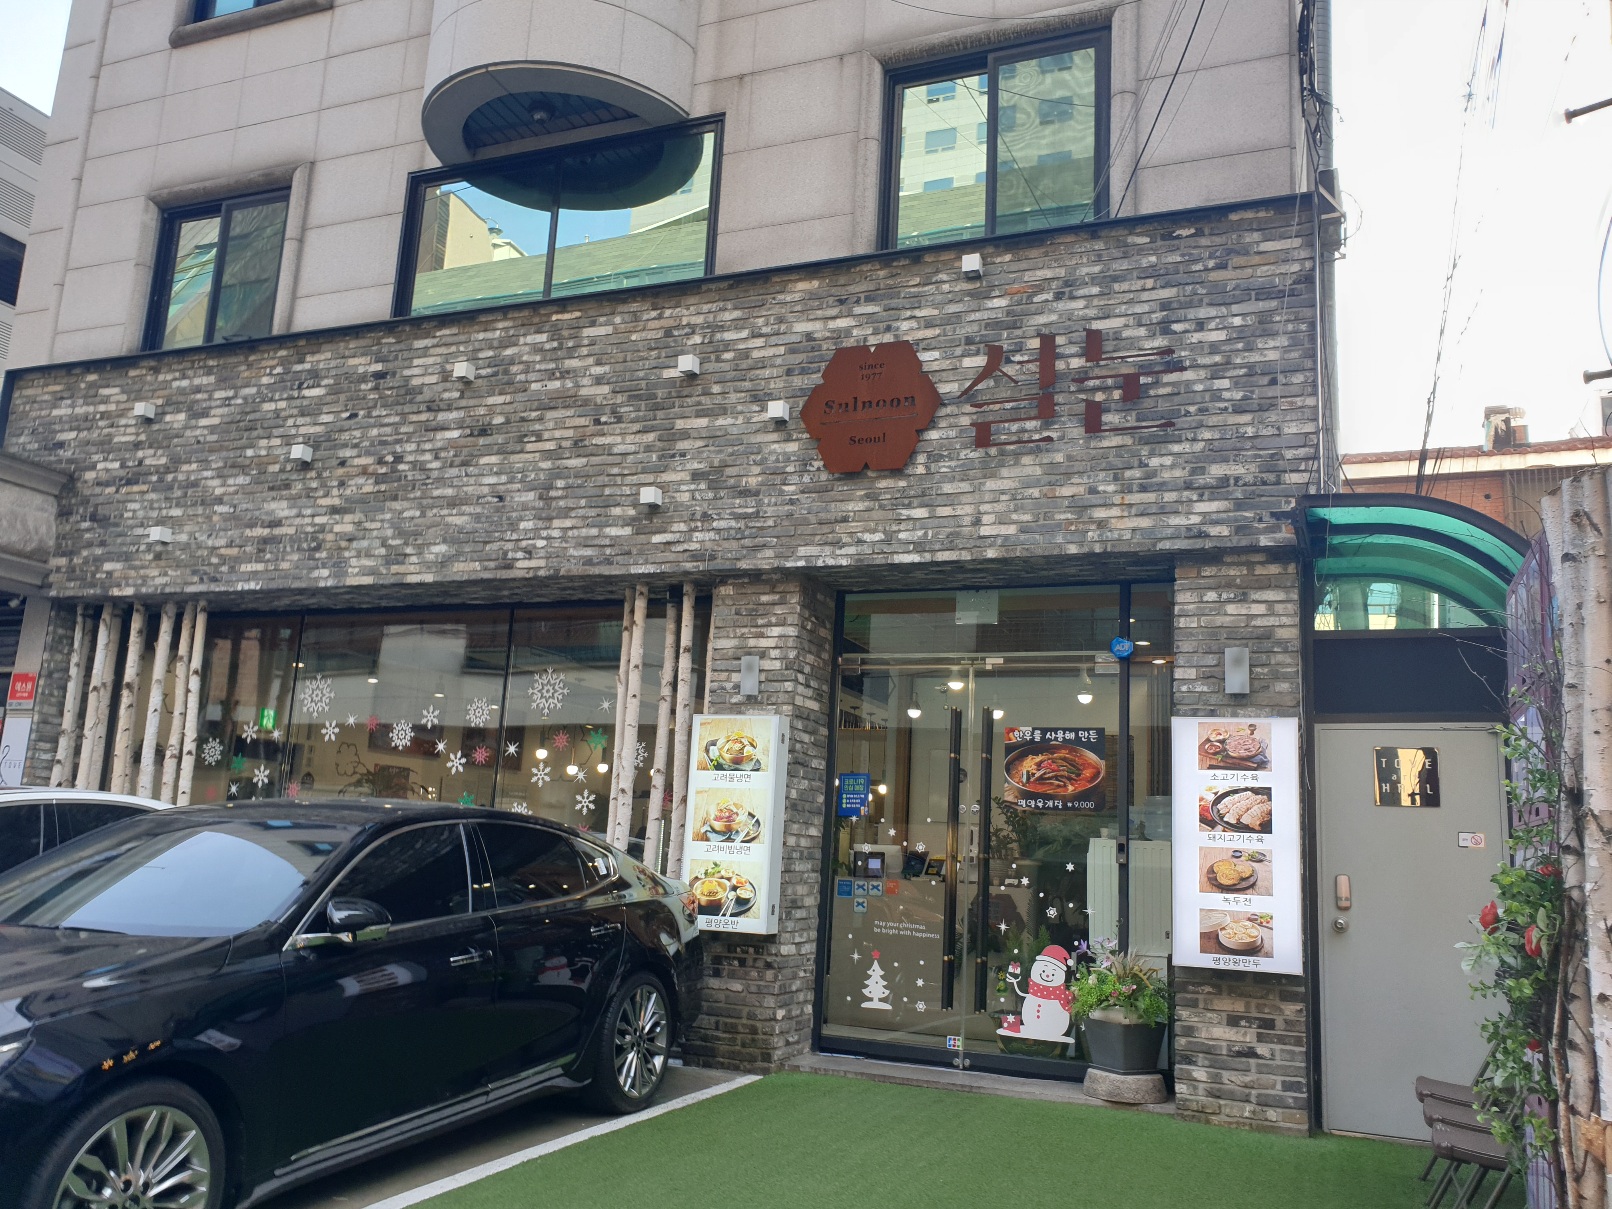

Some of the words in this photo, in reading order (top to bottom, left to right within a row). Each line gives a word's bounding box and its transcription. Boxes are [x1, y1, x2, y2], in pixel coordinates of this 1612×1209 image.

[858, 362, 885, 371] since
[861, 372, 883, 381] 1977
[823, 395, 917, 415] Sulnoon
[848, 432, 887, 446] Seoul
[1014, 729, 1043, 742] 한우를
[1045, 730, 1076, 742] 사용해
[1078, 730, 1099, 743] 만든
[711, 773, 752, 783] 고려물냉면
[1209, 773, 1260, 783] 소고기수육
[1017, 798, 1063, 809] 평양육개장
[1207, 833, 1265, 844] 돼지고기수육
[704, 844, 751, 856] 고려비빔냉면
[1221, 895, 1252, 907] 녹두전
[704, 917, 740, 930] 평양온반
[881, 927, 899, 935] bright
[912, 931, 940, 939] happiness
[1212, 956, 1261, 969] 평양왕만두
